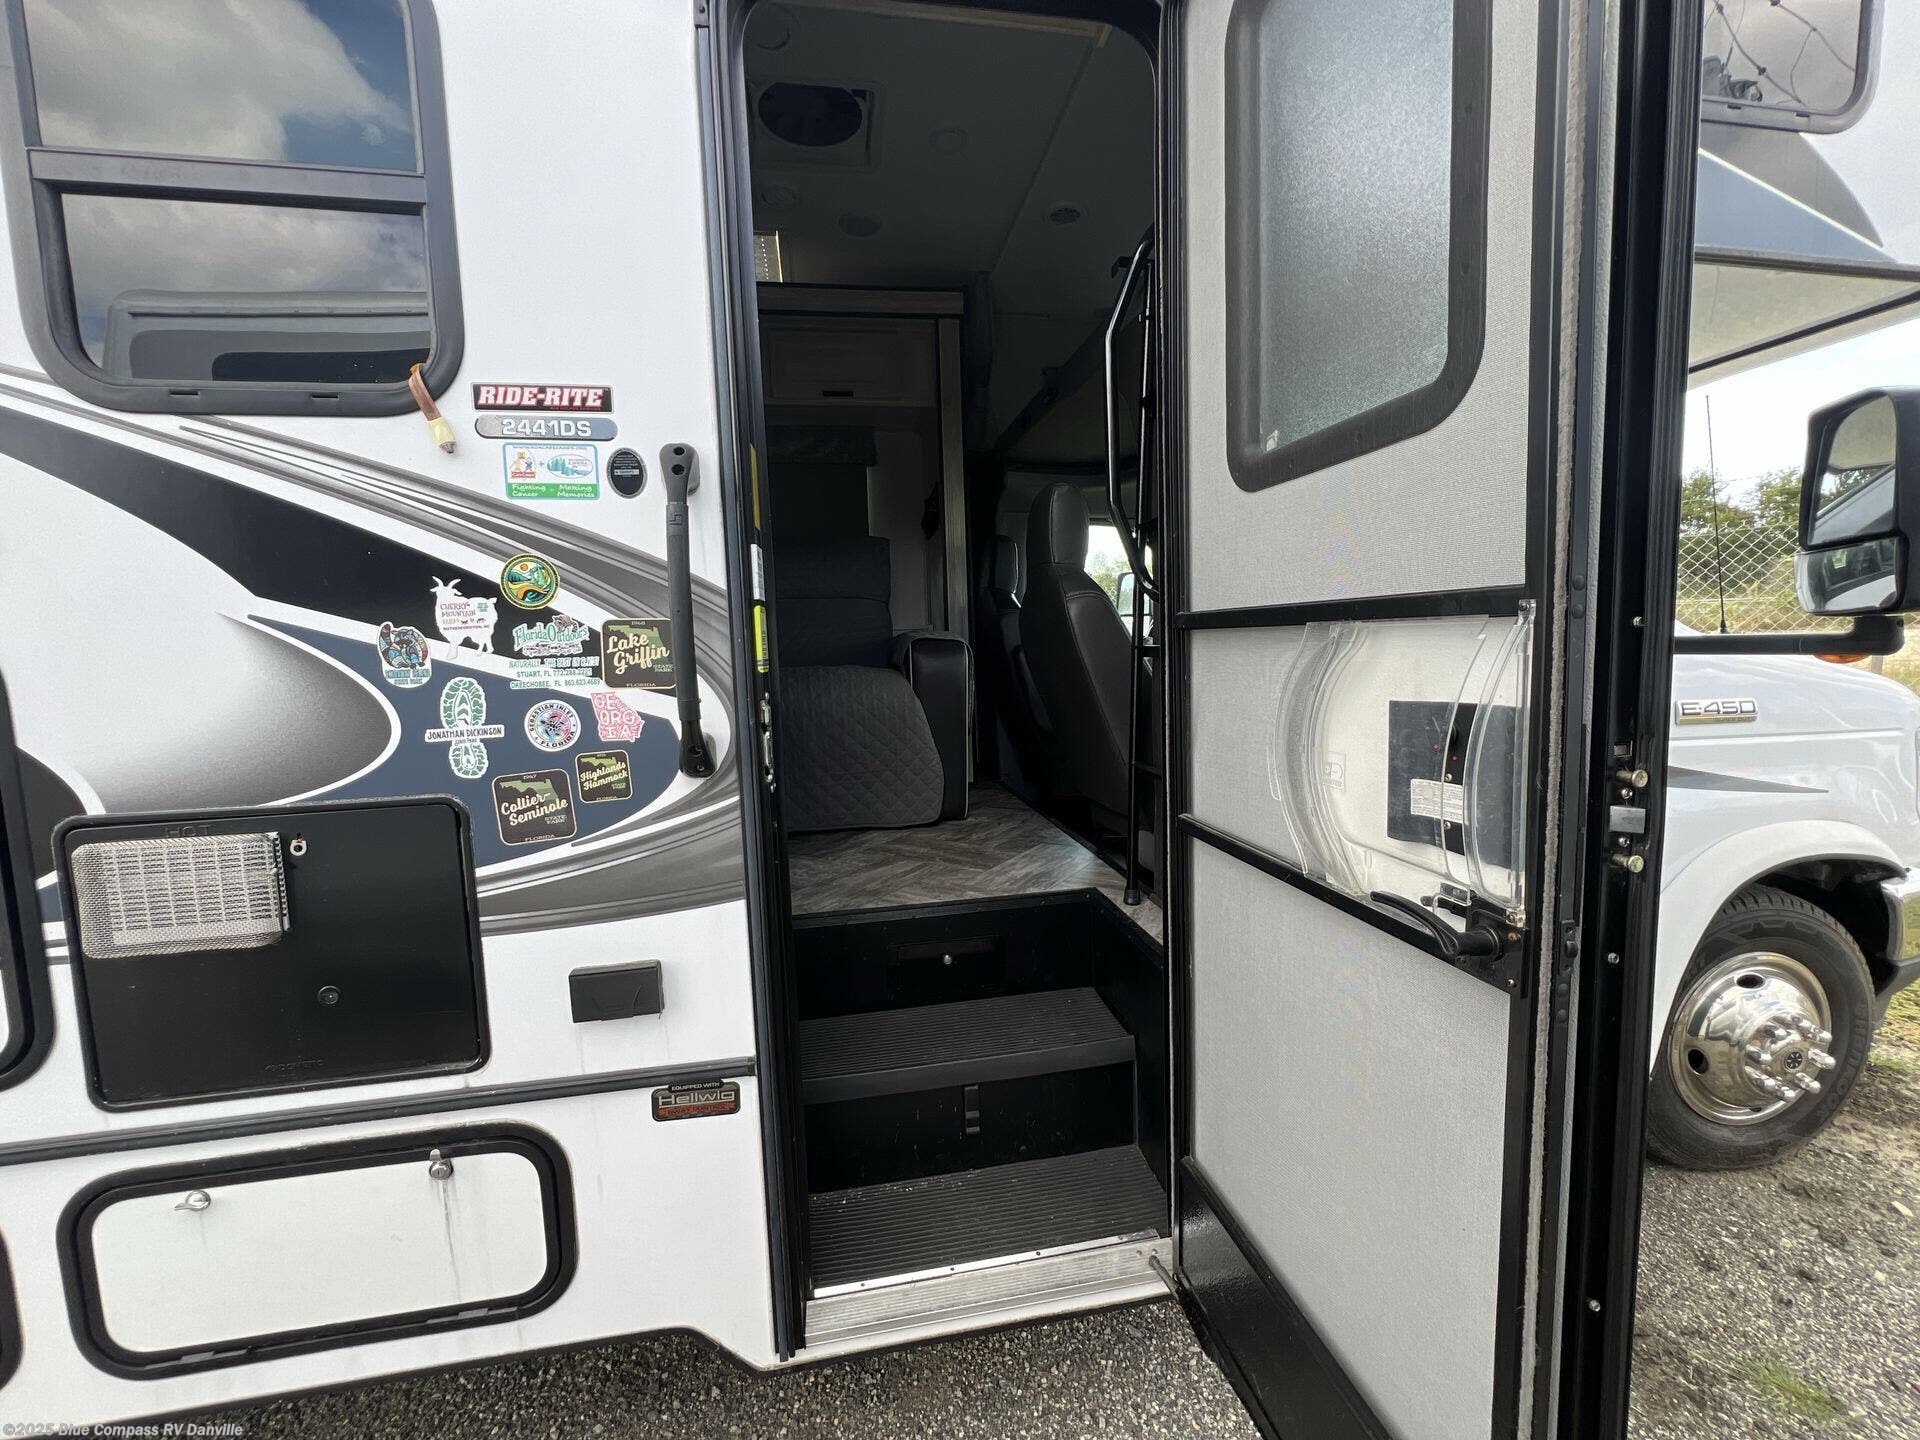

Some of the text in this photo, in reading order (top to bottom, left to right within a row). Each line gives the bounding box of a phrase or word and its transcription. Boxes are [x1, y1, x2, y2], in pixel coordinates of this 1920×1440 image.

[478, 386, 604, 406] RIDE-RITE
[502, 418, 592, 437] 2441DS
[512, 484, 546, 492] Fighting
[559, 484, 592, 492] Making
[441, 609, 476, 618] MOUNTAIN
[607, 633, 648, 653] Lake
[614, 645, 669, 674] Griffin
[517, 670, 542, 678] STUART,
[427, 727, 502, 740] JONATHAN DICKINSON
[540, 731, 575, 748] FLORIDA
[579, 761, 627, 782] Highlands
[583, 770, 629, 790] Hammock
[501, 793, 551, 815] Collier-
[509, 799, 569, 826] Seminole
[525, 834, 556, 842] FLORIDA
[659, 1090, 735, 1106] Hellwig
